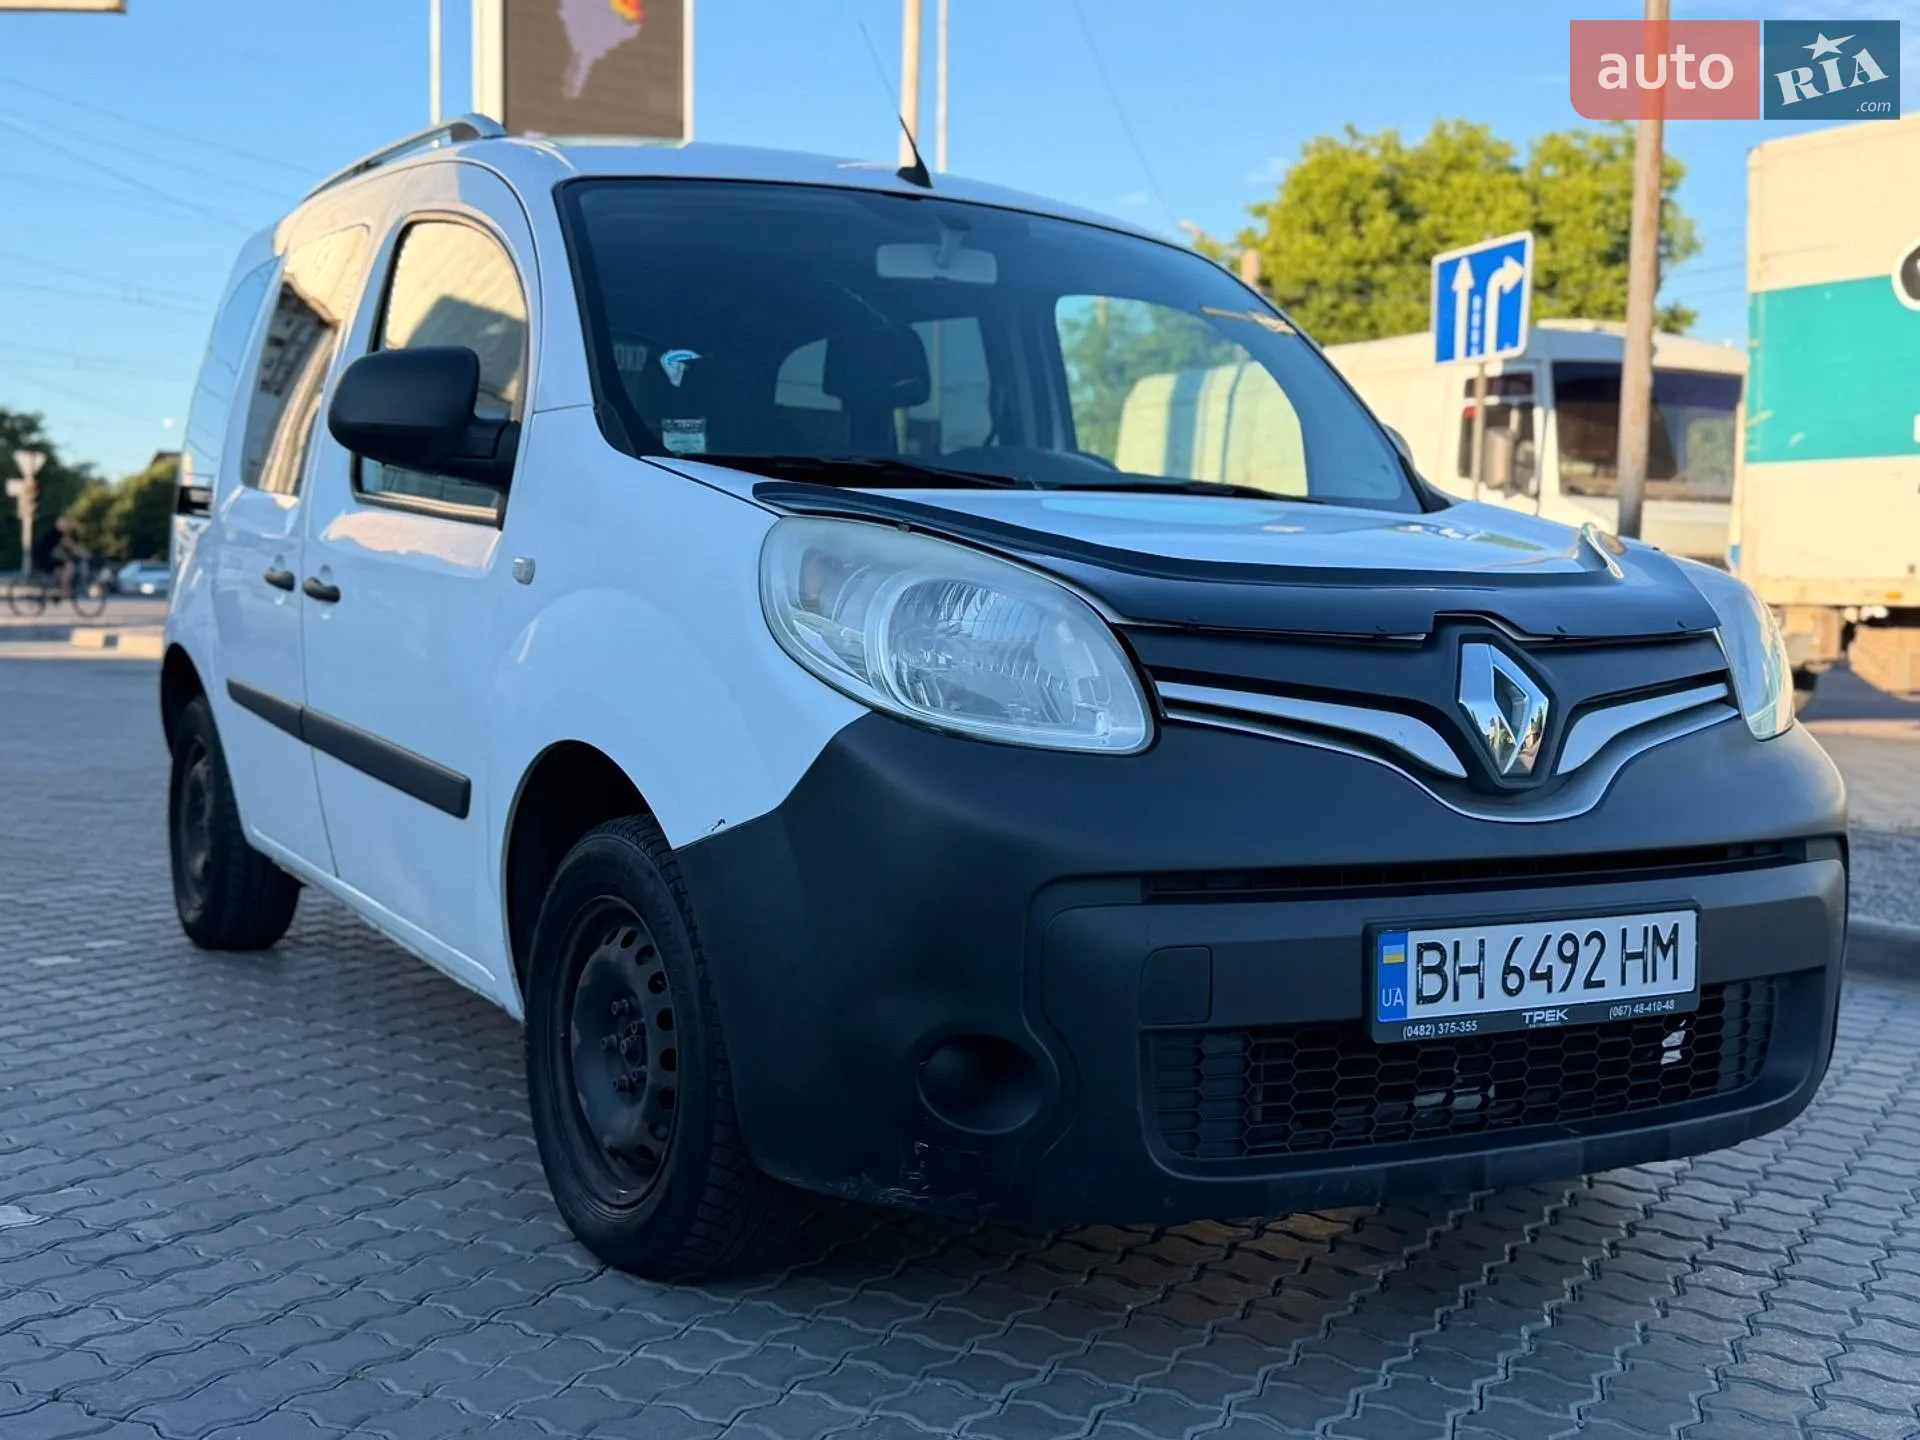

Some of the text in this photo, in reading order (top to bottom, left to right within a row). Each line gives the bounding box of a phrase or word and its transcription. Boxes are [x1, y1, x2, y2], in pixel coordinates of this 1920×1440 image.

[1415, 922, 1680, 1006] BH 6492 HM
[1382, 987, 1405, 1008] UA
[1402, 1019, 1478, 1041] (0482) 375-355
